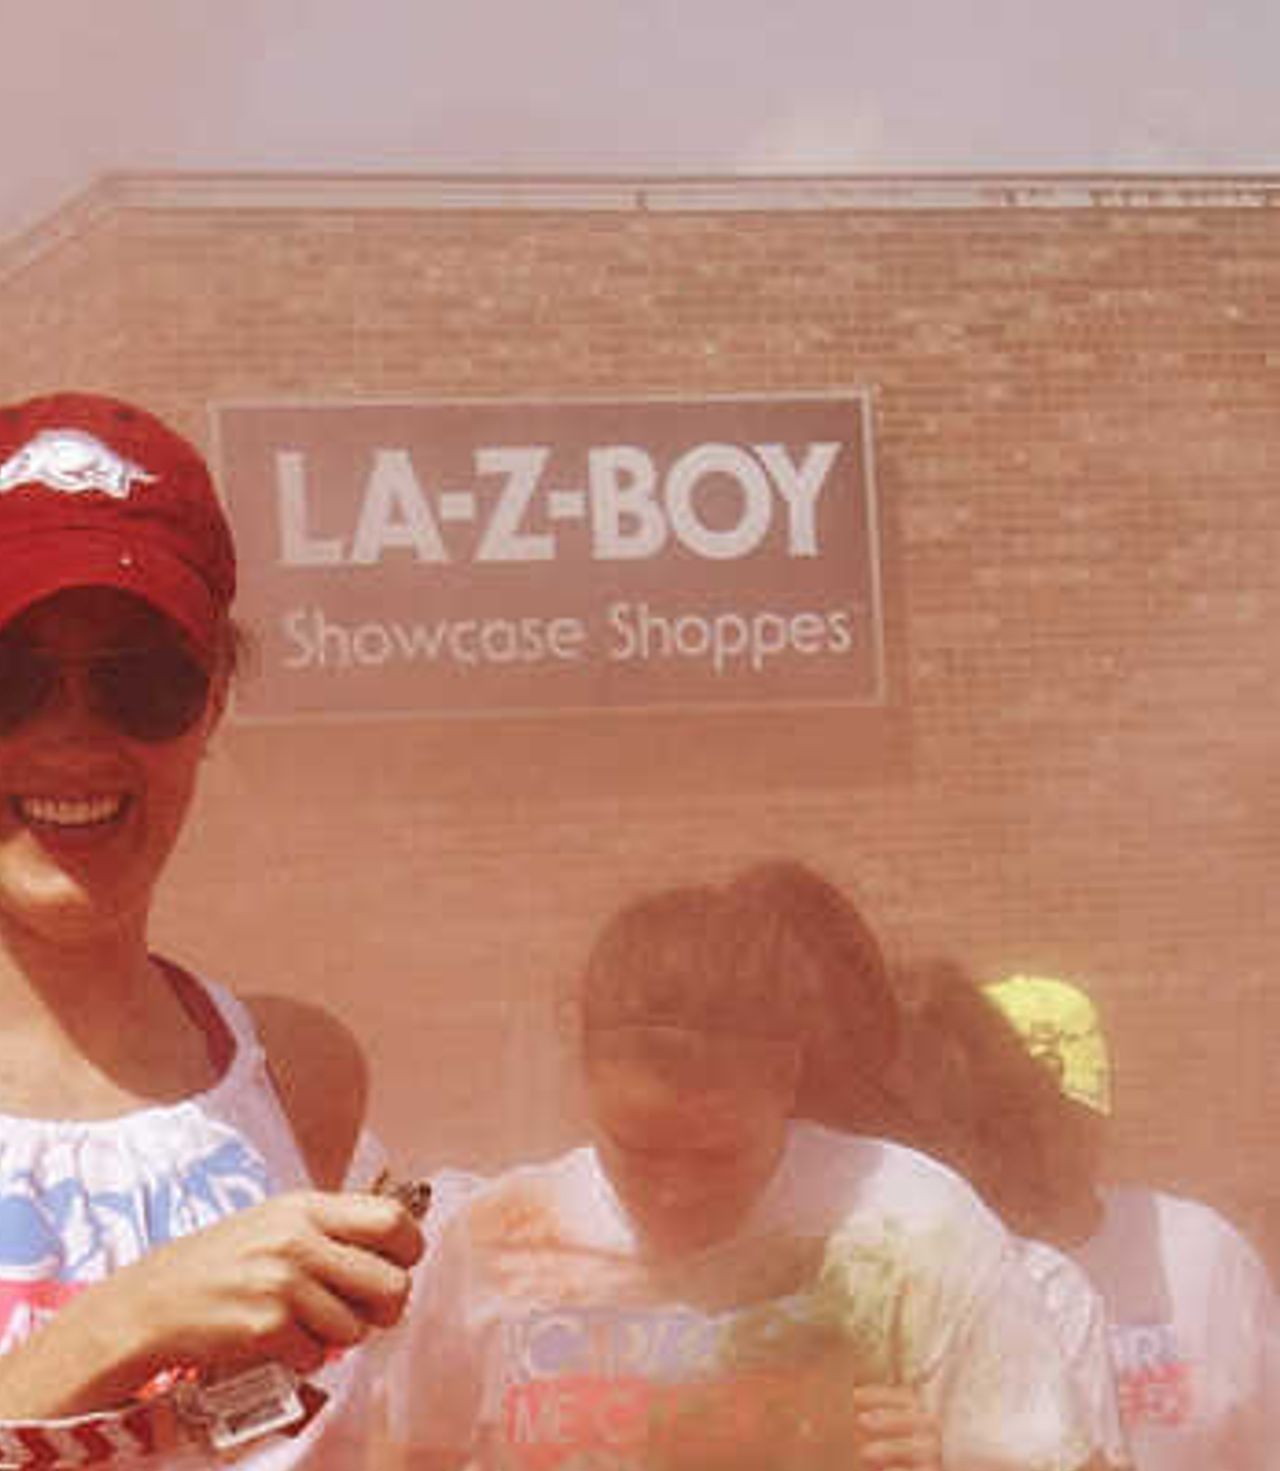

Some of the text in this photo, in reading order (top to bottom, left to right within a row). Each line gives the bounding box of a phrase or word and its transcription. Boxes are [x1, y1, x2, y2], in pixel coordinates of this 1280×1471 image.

[275, 441, 841, 567] LA-Z-BOY
[283, 602, 852, 672] Showcase Shoppes
